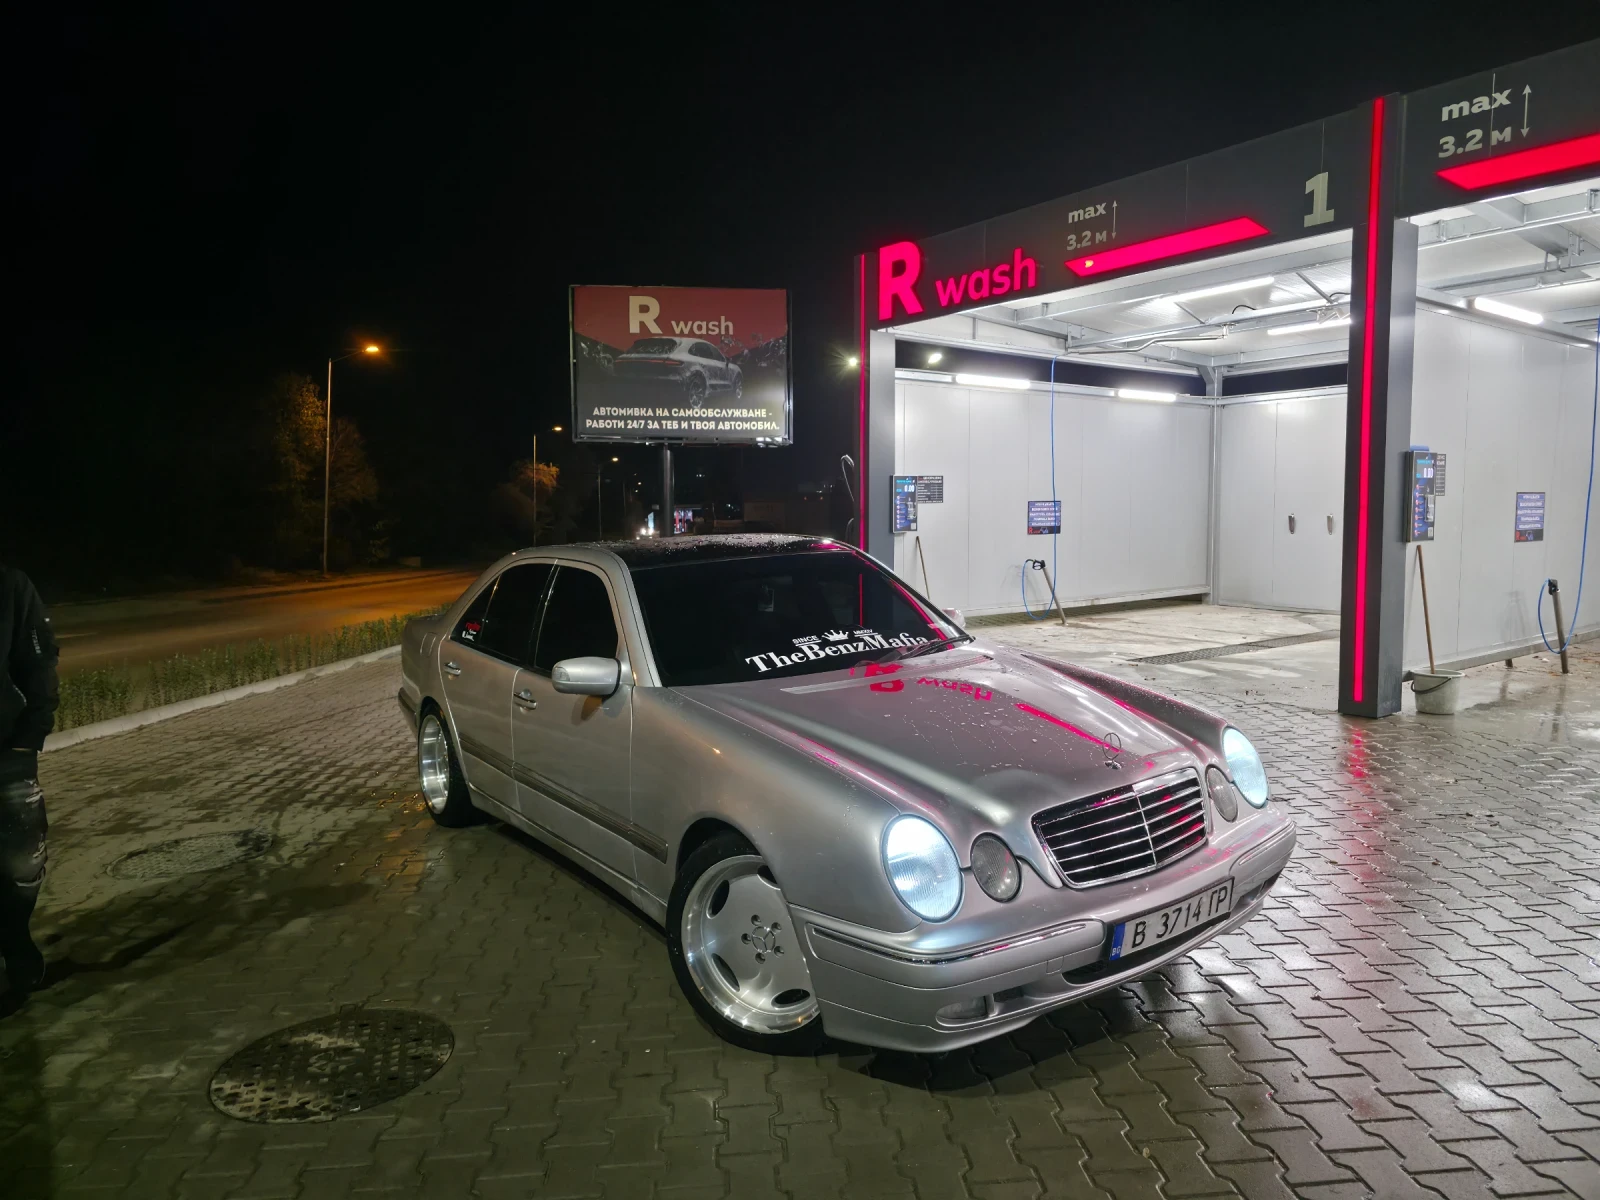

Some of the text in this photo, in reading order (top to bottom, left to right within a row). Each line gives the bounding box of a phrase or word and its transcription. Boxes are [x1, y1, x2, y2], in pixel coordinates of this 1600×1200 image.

[1441, 88, 1512, 122] max
[1438, 128, 1483, 158] 3.2
[1067, 202, 1107, 224] max
[1303, 172, 1335, 228] 1
[1065, 230, 1092, 251] 3.2
[878, 241, 1036, 321] R wash
[628, 295, 734, 335] R wash
[586, 419, 780, 431] РАБОТИ 24/7 ЗА ТЕБ И ТВОЯ АВТОМОБИЛ.
[593, 407, 653, 417] АВТОМИВКА
[655, 408, 670, 417] НА
[671, 408, 767, 418] САМООБСЛУЖВАНЕ
[745, 633, 929, 673] TheBenzMafia
[792, 635, 818, 646] SINCE
[1156, 896, 1203, 939] 3714
